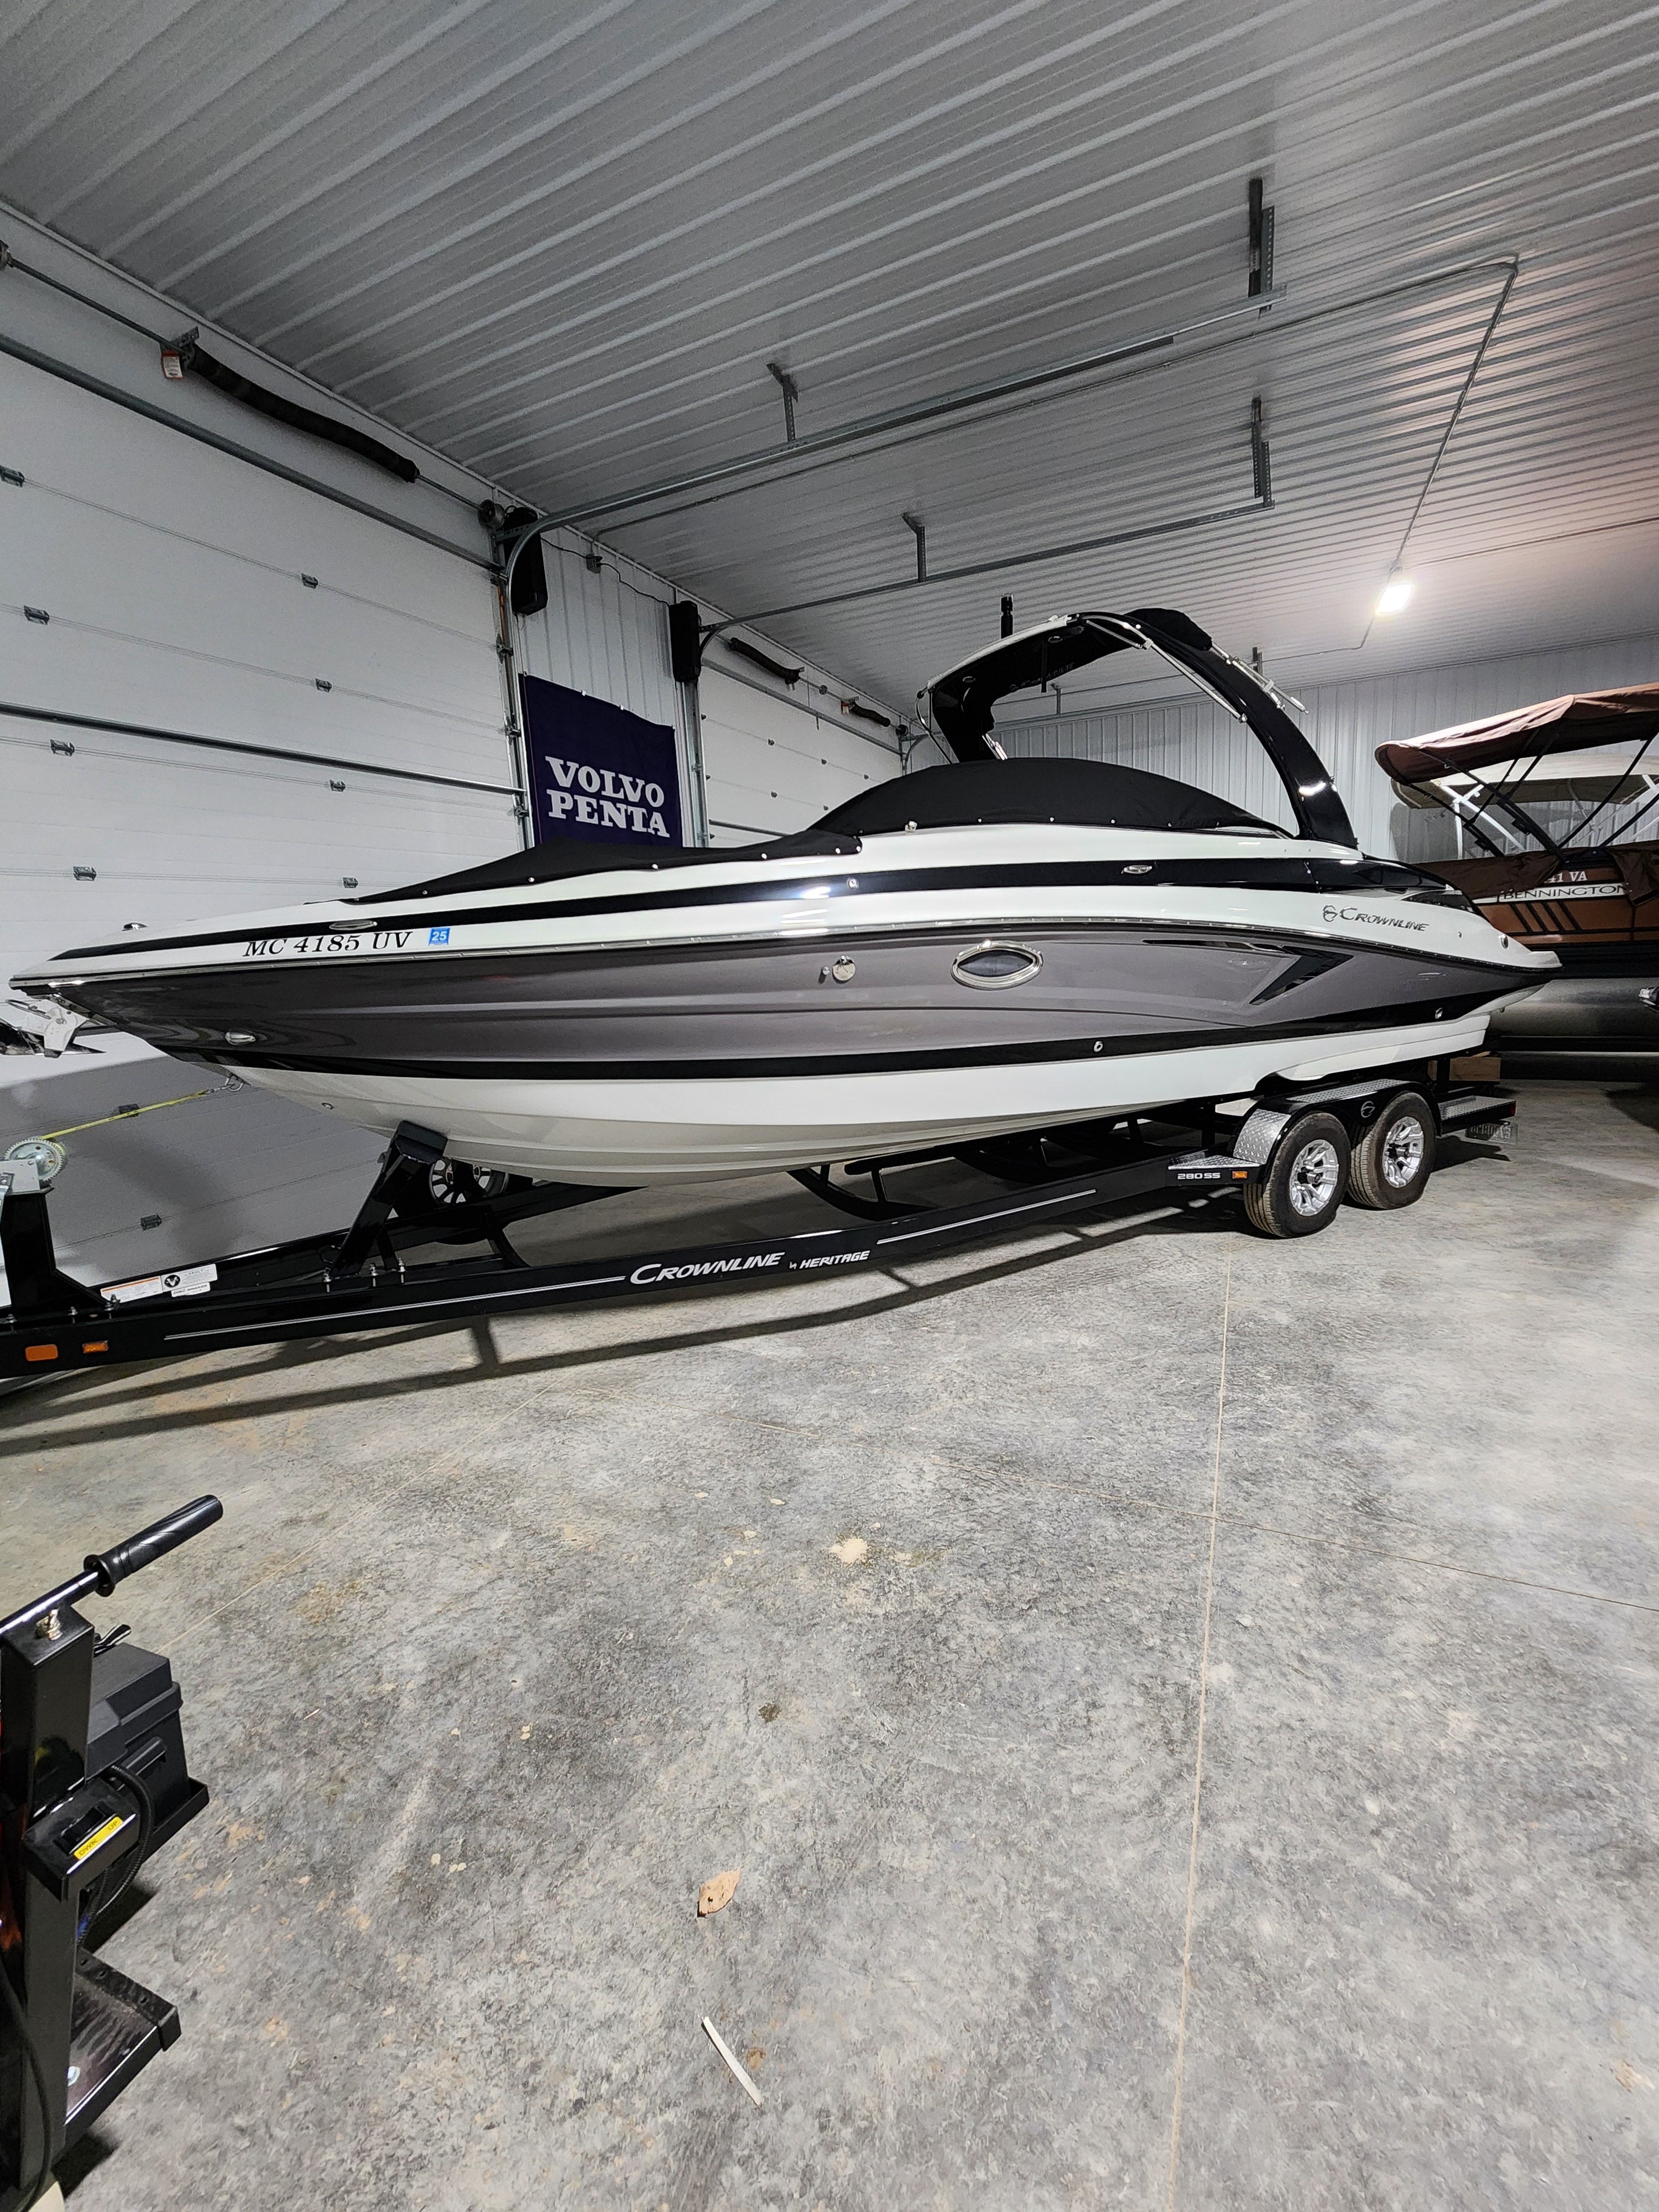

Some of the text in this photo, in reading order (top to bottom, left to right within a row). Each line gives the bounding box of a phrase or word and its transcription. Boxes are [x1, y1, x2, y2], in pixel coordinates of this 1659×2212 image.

[545, 756, 664, 807] VOLVO
[546, 789, 670, 838] PENTA
[1569, 872, 1588, 882] VA
[1339, 906, 1430, 931] CROWNLINE
[242, 931, 414, 957] MC 4185 UV
[431, 931, 447, 941] 25
[630, 1252, 785, 1284] CROWNLINE
[800, 1250, 870, 1269] HERITAGE
[108, 1820, 118, 1831] UP
